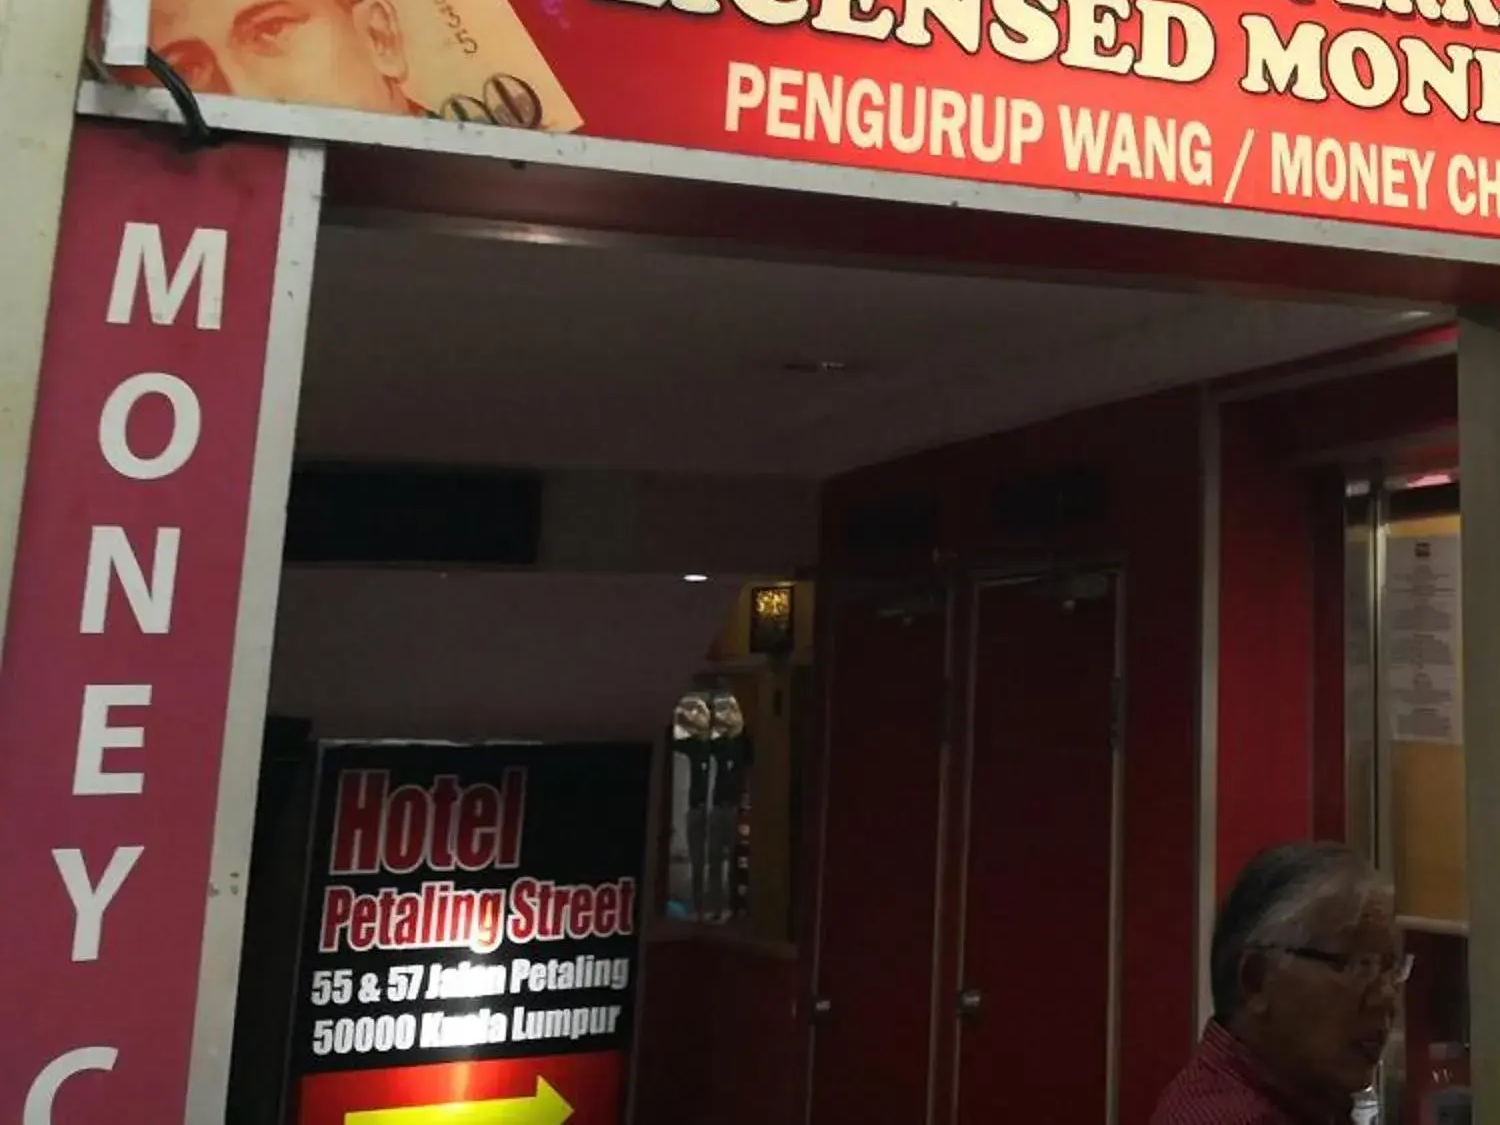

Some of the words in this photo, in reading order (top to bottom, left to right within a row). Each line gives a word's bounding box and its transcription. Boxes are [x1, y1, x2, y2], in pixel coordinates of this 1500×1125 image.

[724, 61, 1045, 166] PENGURUP
[1058, 103, 1213, 187] WANG
[1271, 133, 1433, 211] MONEY
[52, 222, 228, 962] MONEY
[330, 767, 528, 875] Hotel
[319, 881, 504, 954] Petaling
[507, 877, 634, 940] Street
[311, 970, 353, 1006] 55
[357, 973, 381, 1003] &
[387, 966, 425, 1001] 57
[510, 955, 630, 991] Petaling
[312, 1014, 416, 1055] 50000
[511, 1006, 621, 1042] Lumpur
